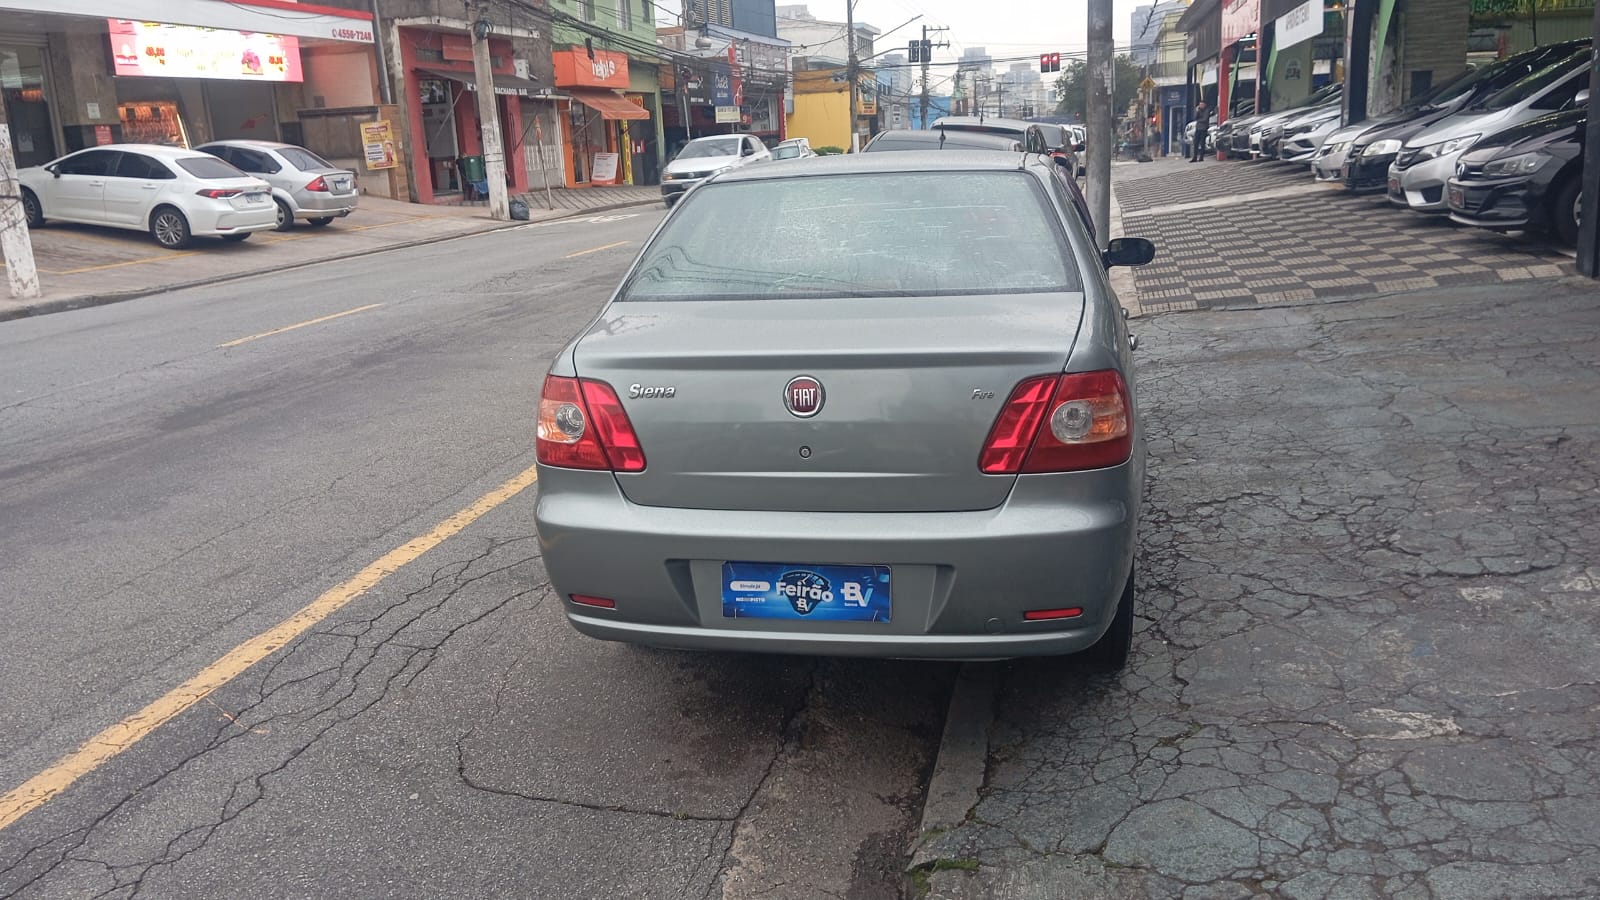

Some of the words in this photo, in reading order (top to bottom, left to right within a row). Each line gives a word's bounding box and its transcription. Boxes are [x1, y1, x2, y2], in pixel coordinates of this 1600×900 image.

[629, 383, 676, 399] Siena
[793, 388, 816, 406] FIAT
[972, 388, 994, 400] Fire
[776, 581, 834, 603] Feirão
